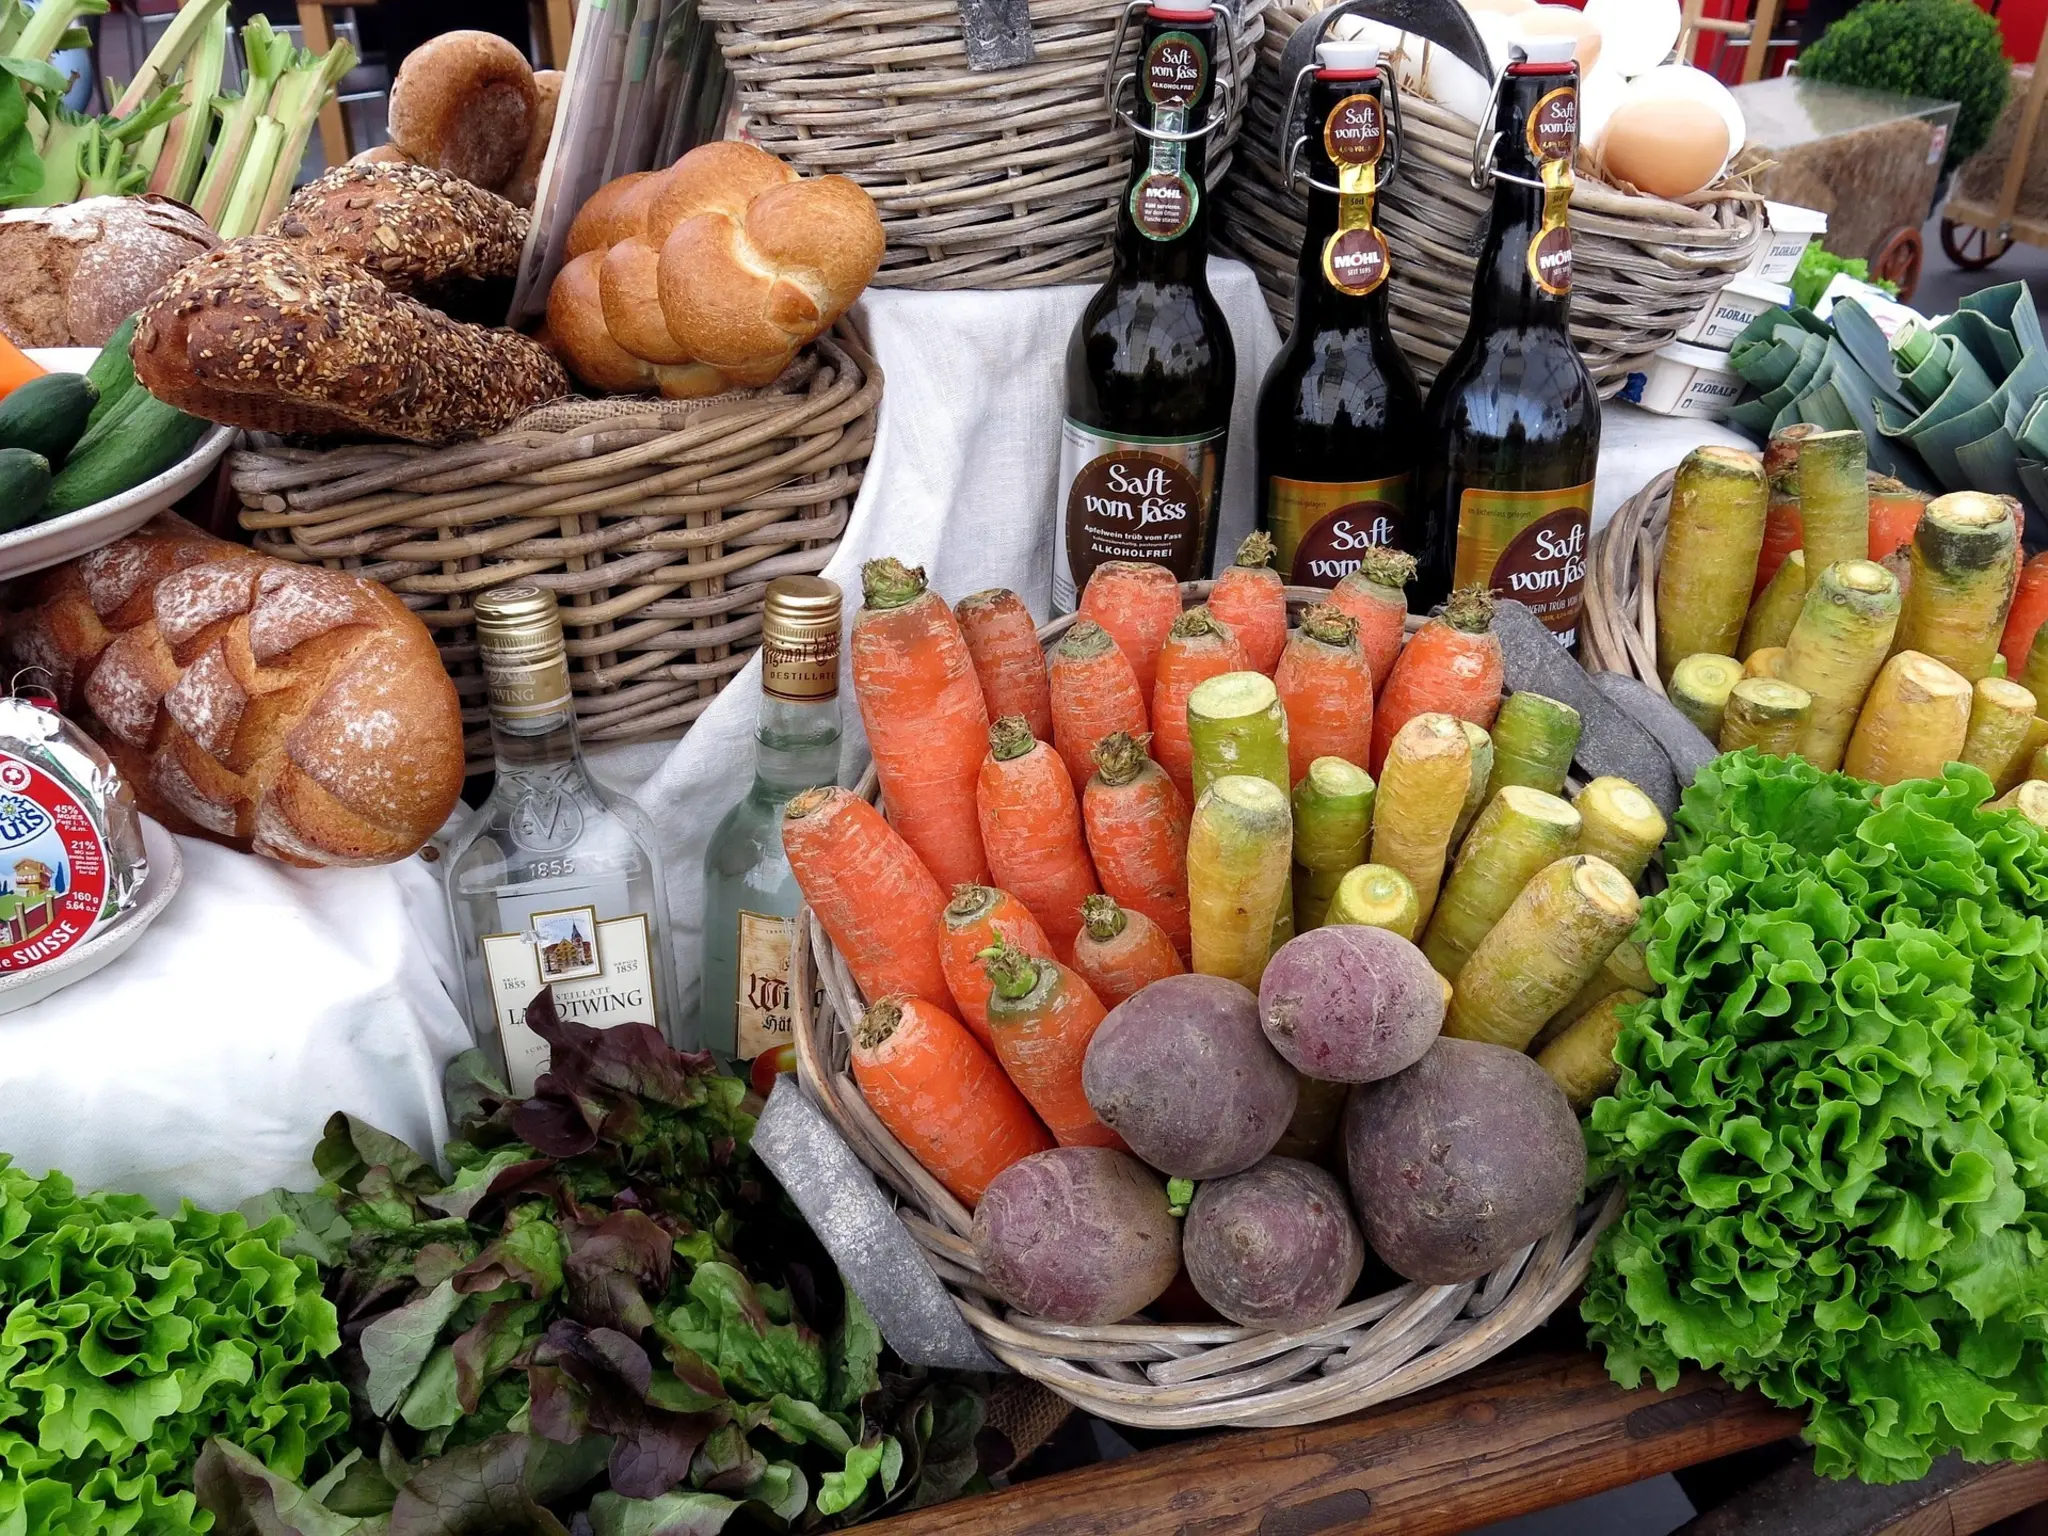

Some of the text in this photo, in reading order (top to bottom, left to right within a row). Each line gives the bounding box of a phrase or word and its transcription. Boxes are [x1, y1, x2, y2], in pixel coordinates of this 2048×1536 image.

[1162, 48, 1191, 64] Saft
[1151, 66, 1174, 78] vom
[1152, 82, 1194, 90] ALKOHOLFREI
[1345, 107, 1374, 125] Saft
[1550, 101, 1575, 119] Saft
[1335, 128, 1360, 139] vom
[1539, 122, 1562, 134] vom
[1146, 187, 1181, 199] MÖHL
[1769, 245, 1802, 257] FLORALP
[1334, 251, 1381, 269] MÖHL
[1347, 268, 1359, 276] SEIT
[1691, 382, 1738, 397] FLORALP
[1105, 464, 1172, 498] Saft
[1084, 495, 1134, 521] vom
[1084, 524, 1123, 539] Apfelwein
[1124, 532, 1143, 541] trüb
[1163, 532, 1182, 541] Fass
[1329, 516, 1394, 550] Saft
[1531, 523, 1585, 560] Saft
[1091, 543, 1172, 558] ALKOHOLFREI
[1507, 568, 1561, 591] vom
[763, 641, 807, 668] riginal
[54, 804, 79, 815] 45%
[0, 808, 44, 841] uis
[71, 840, 96, 850] 21%
[529, 858, 576, 878] 1855
[73, 891, 91, 901] 160
[66, 901, 84, 911] 5.64
[13, 920, 79, 964] SUISSE
[616, 963, 638, 974] 1855
[504, 980, 526, 990] 1855
[555, 986, 611, 1001] STILLATE
[508, 989, 643, 1025] LADTWING
